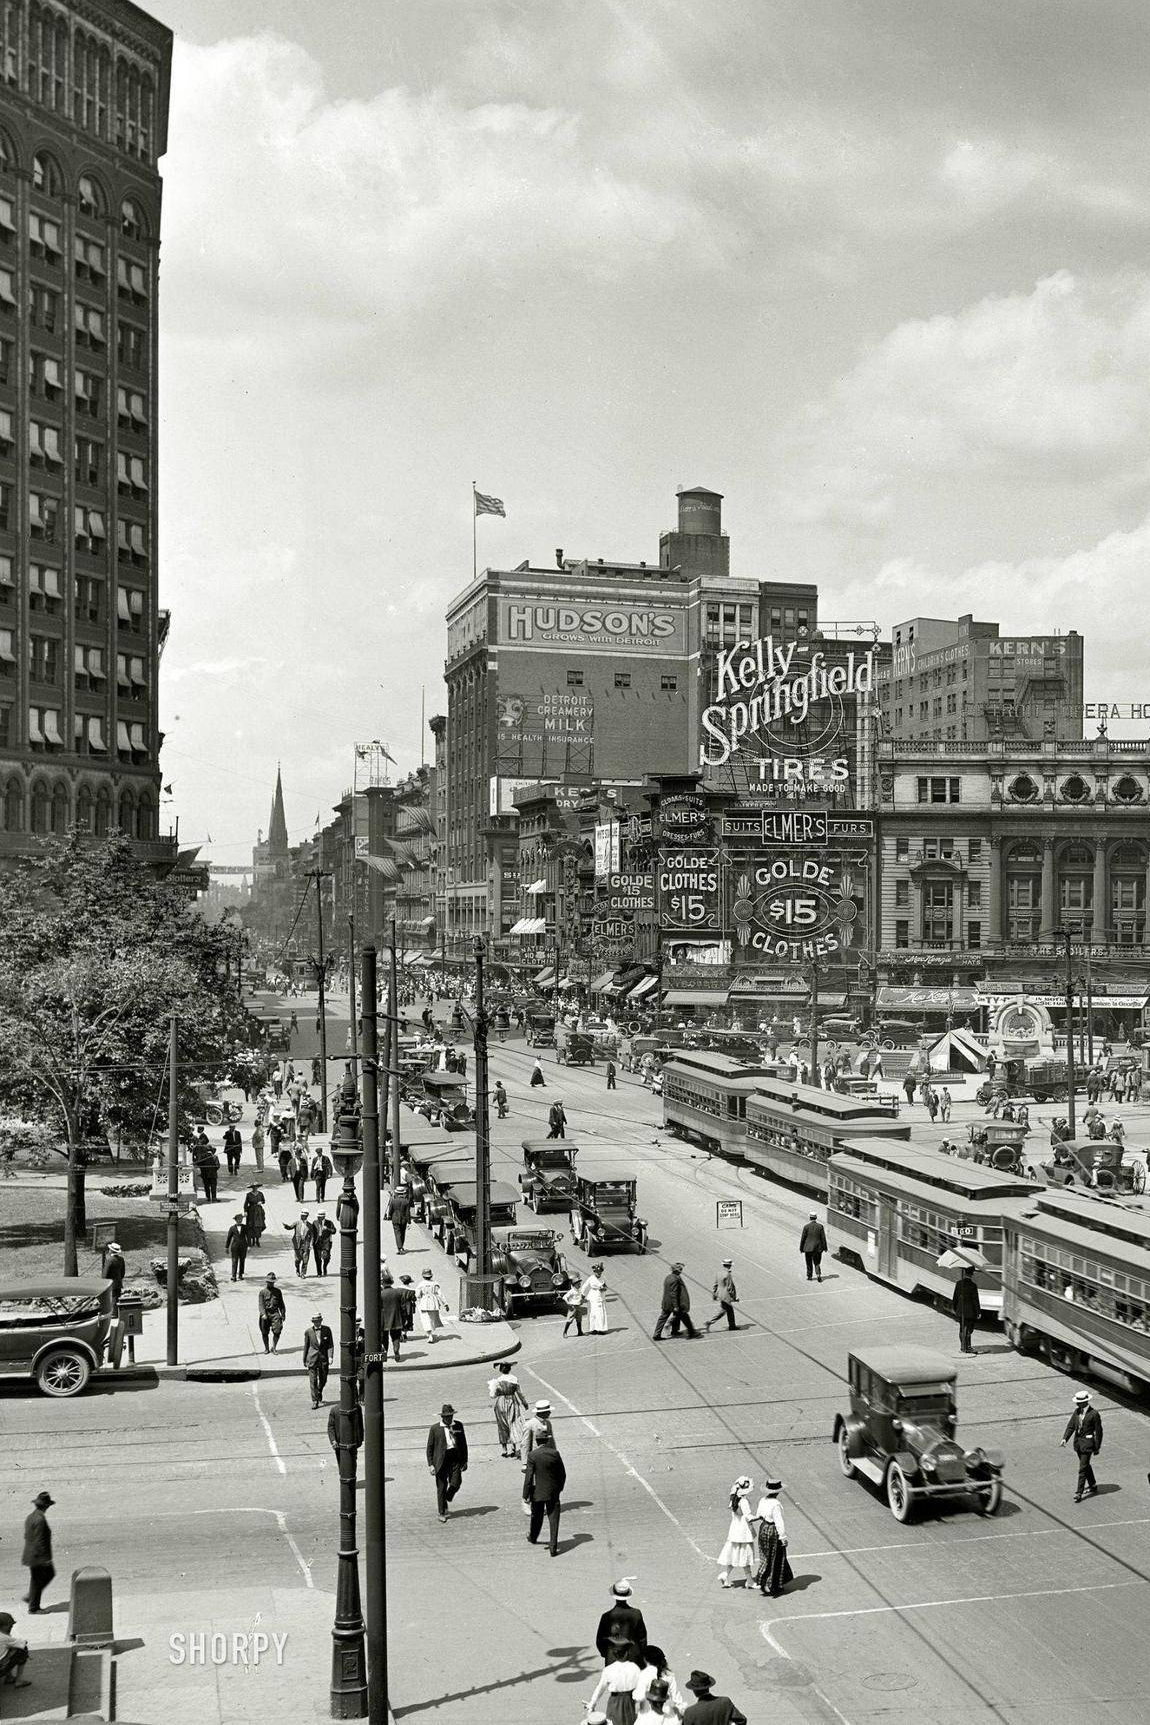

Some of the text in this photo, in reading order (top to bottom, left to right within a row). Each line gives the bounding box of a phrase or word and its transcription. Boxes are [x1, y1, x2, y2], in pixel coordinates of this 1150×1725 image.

[509, 606, 675, 639] HUDSON'S
[542, 633, 584, 641] GROWS
[616, 637, 663, 646] DETROIT
[945, 644, 970, 661] CLOTHES
[989, 641, 1066, 655] KERN'S
[1016, 658, 1042, 666] STORES
[544, 695, 588, 705] DETROIT
[537, 706, 593, 717] CREAMERY
[700, 651, 875, 766] Springfield
[545, 718, 585, 731] MILK
[549, 735, 595, 744] INSURANCE
[753, 758, 849, 780] TIRES
[750, 783, 846, 793] MADE TO MAKE GOOD
[556, 799, 579, 808] DRY
[659, 812, 706, 823] ELMER'S
[725, 813, 867, 843] SUITS ELMER'S FURS
[667, 857, 708, 869] GOLDE
[755, 859, 835, 886] GOLDE
[611, 875, 654, 889] GOLDE
[660, 873, 717, 892] CLOTHES
[622, 886, 640, 895] $15
[611, 896, 654, 908] CLOTHES
[671, 895, 705, 920] $15
[769, 899, 817, 925] $15
[752, 931, 839, 960] CLOTHES
[364, 1354, 383, 1362] FORT
